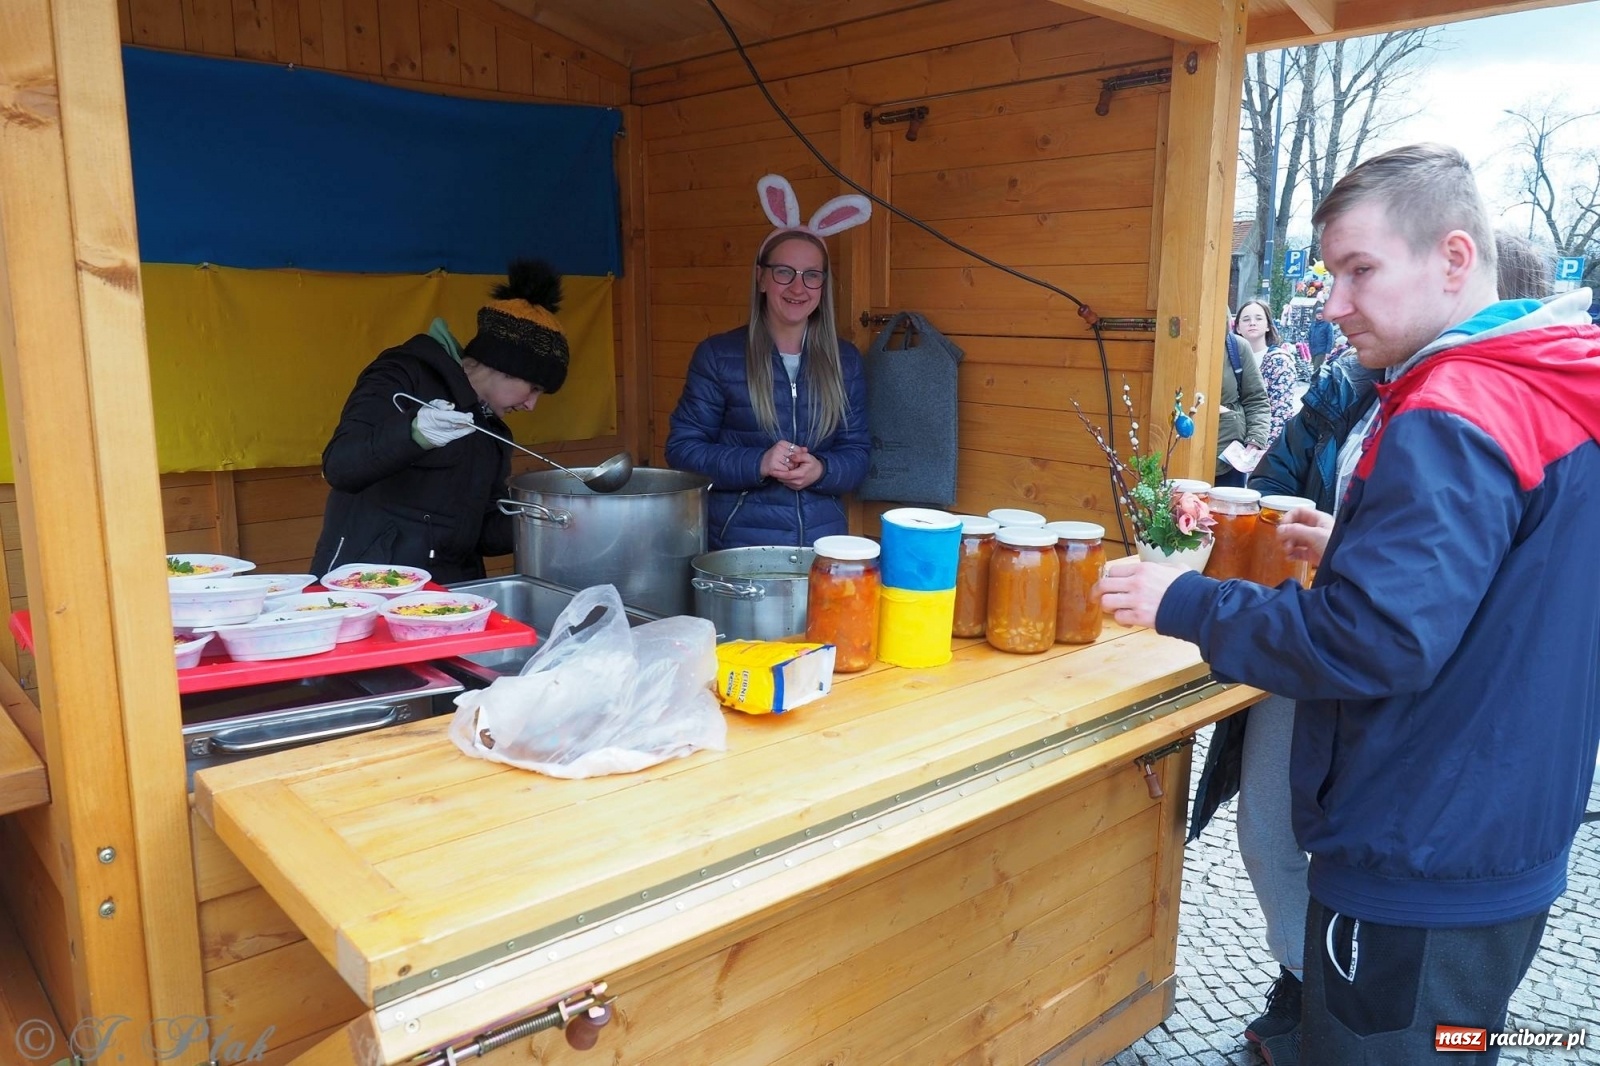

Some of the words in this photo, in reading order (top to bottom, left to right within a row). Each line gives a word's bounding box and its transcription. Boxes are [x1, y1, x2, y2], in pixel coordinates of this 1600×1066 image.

[1290, 251, 1301, 264] P
[1561, 259, 1579, 279] P
[738, 670, 749, 703] LEIBNIZ
